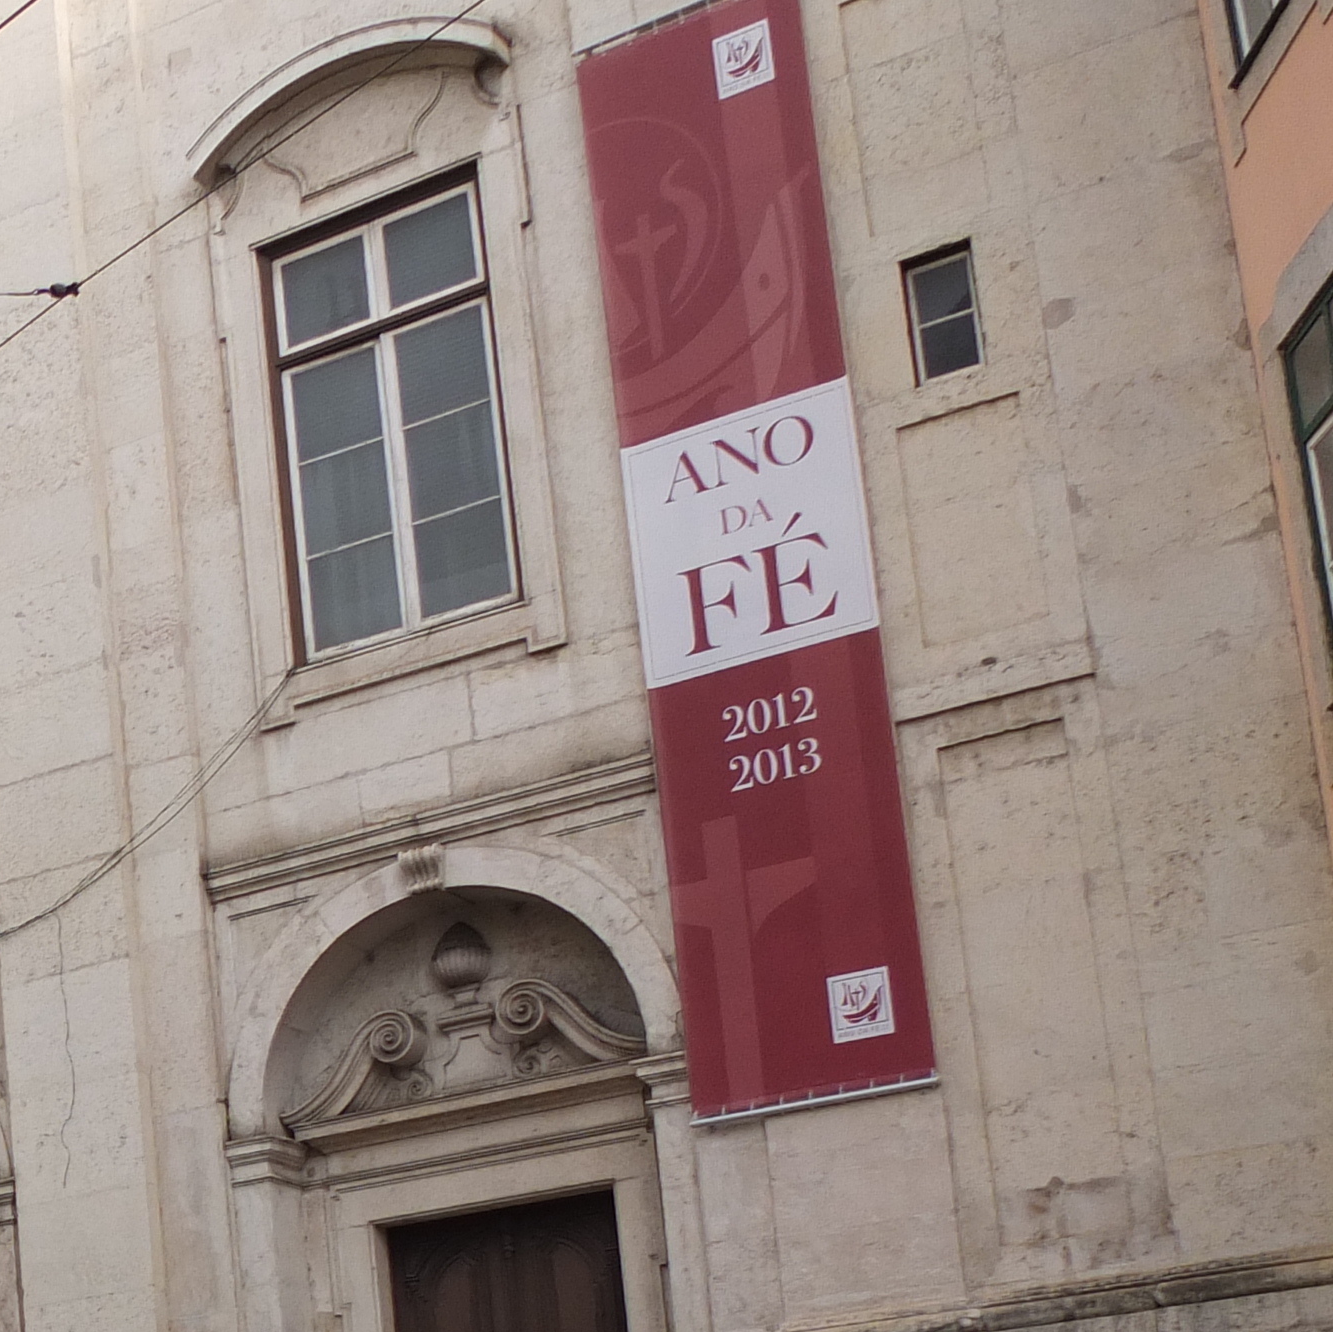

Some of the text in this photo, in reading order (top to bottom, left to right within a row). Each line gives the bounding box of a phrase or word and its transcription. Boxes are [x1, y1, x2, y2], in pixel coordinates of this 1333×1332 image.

[664, 414, 815, 504] ANO
[720, 498, 774, 535] DA
[676, 511, 838, 657] FÉ
[722, 686, 817, 742] 2012
[729, 737, 823, 792] 2013
